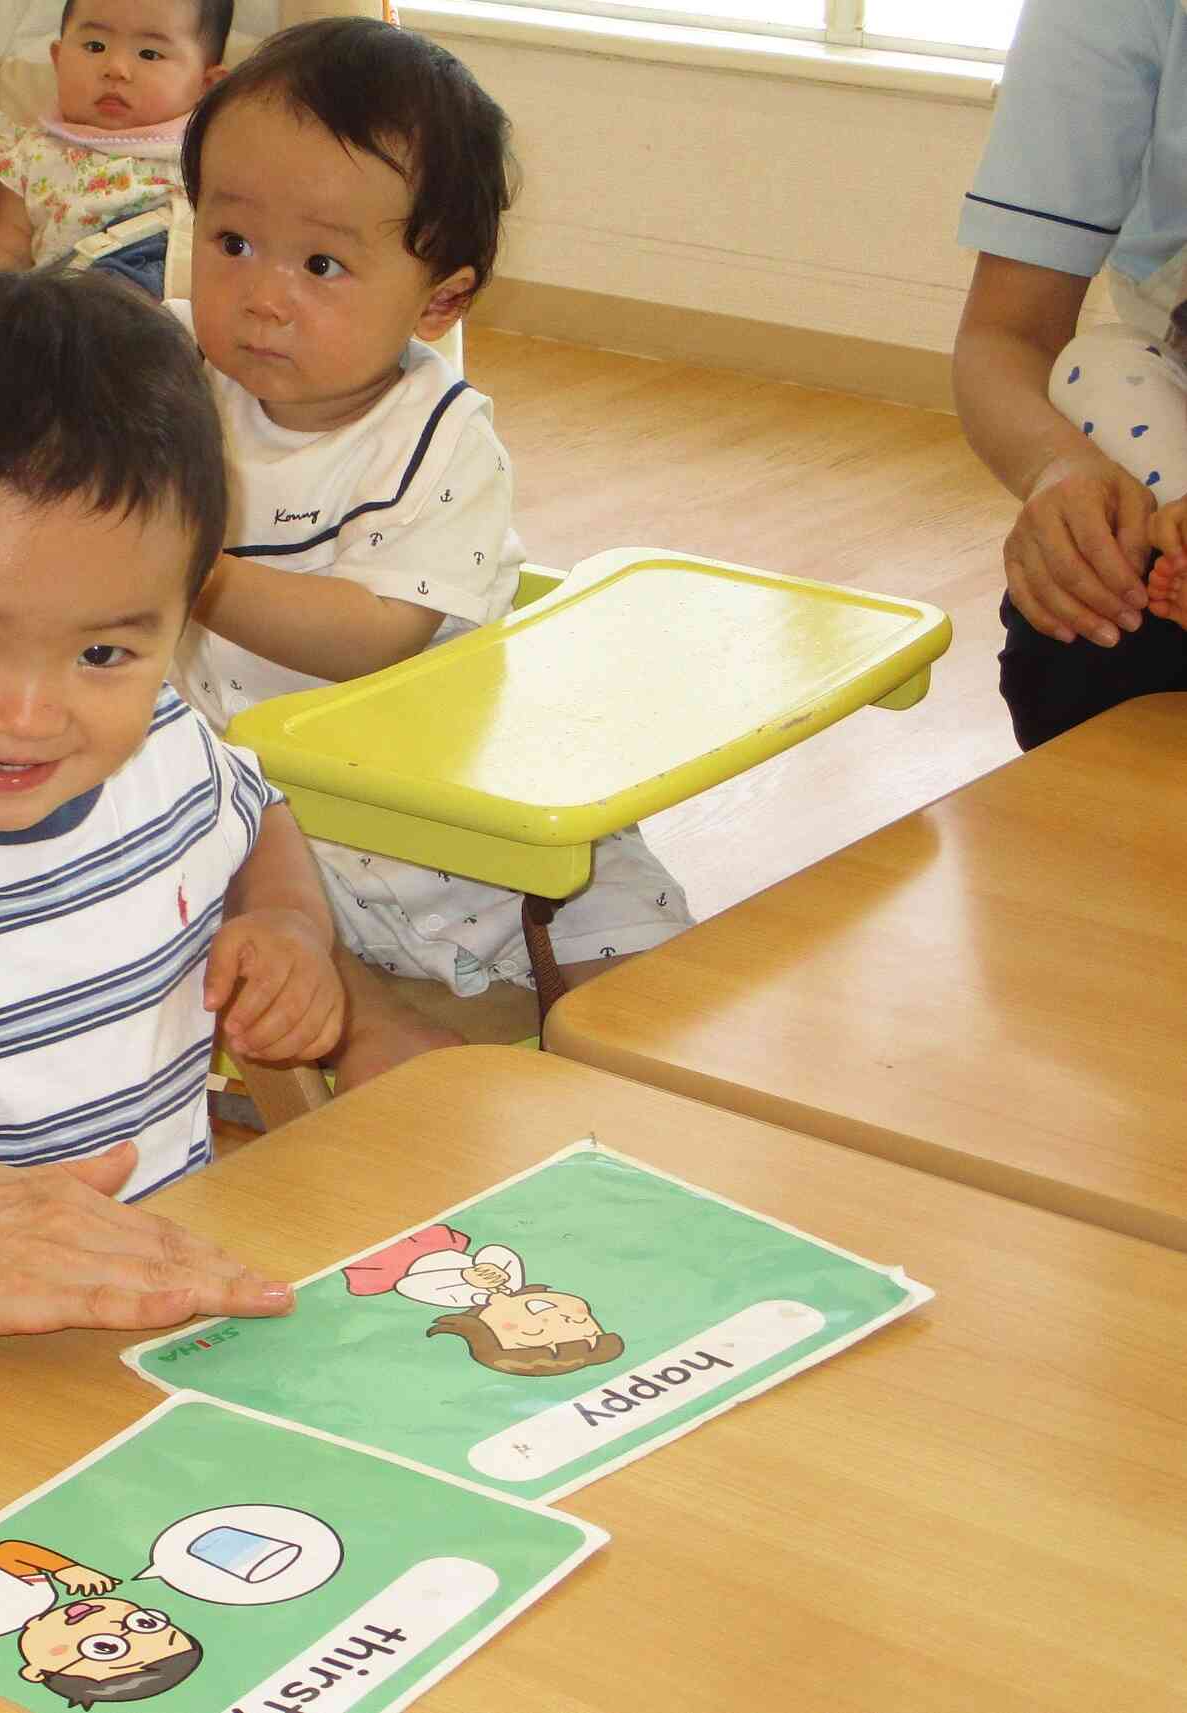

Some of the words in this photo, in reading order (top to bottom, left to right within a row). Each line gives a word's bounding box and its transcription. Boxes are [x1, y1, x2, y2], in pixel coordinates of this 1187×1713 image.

[158, 1327, 240, 1362] SEIHA
[572, 1349, 735, 1427] happy
[232, 1624, 408, 1713] thirst
